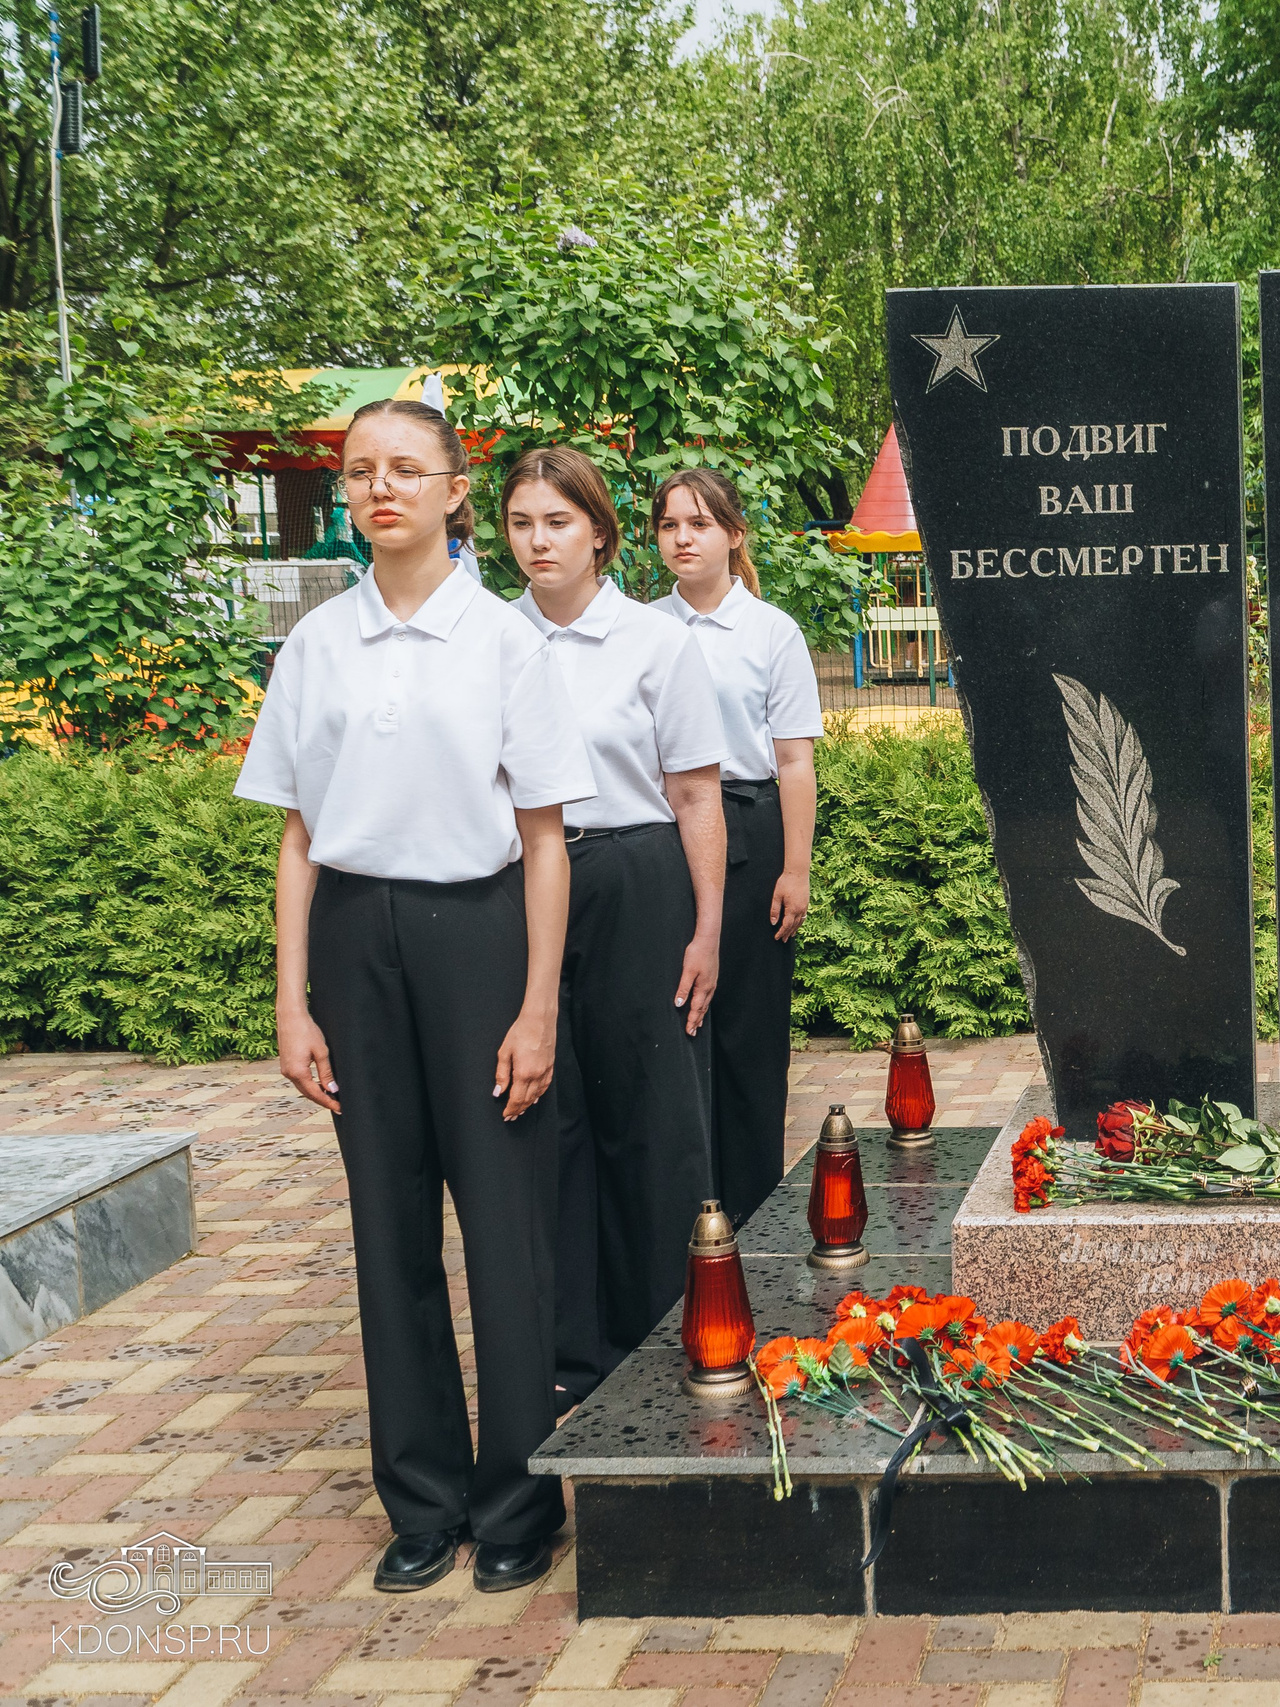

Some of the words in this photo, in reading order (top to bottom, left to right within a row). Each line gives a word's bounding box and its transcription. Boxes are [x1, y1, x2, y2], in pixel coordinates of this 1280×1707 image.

[1002, 424, 1166, 461] ПОДВИГ
[1039, 484, 1133, 515] ВАШ
[951, 544, 1228, 579] БЕССМЕРТЕН
